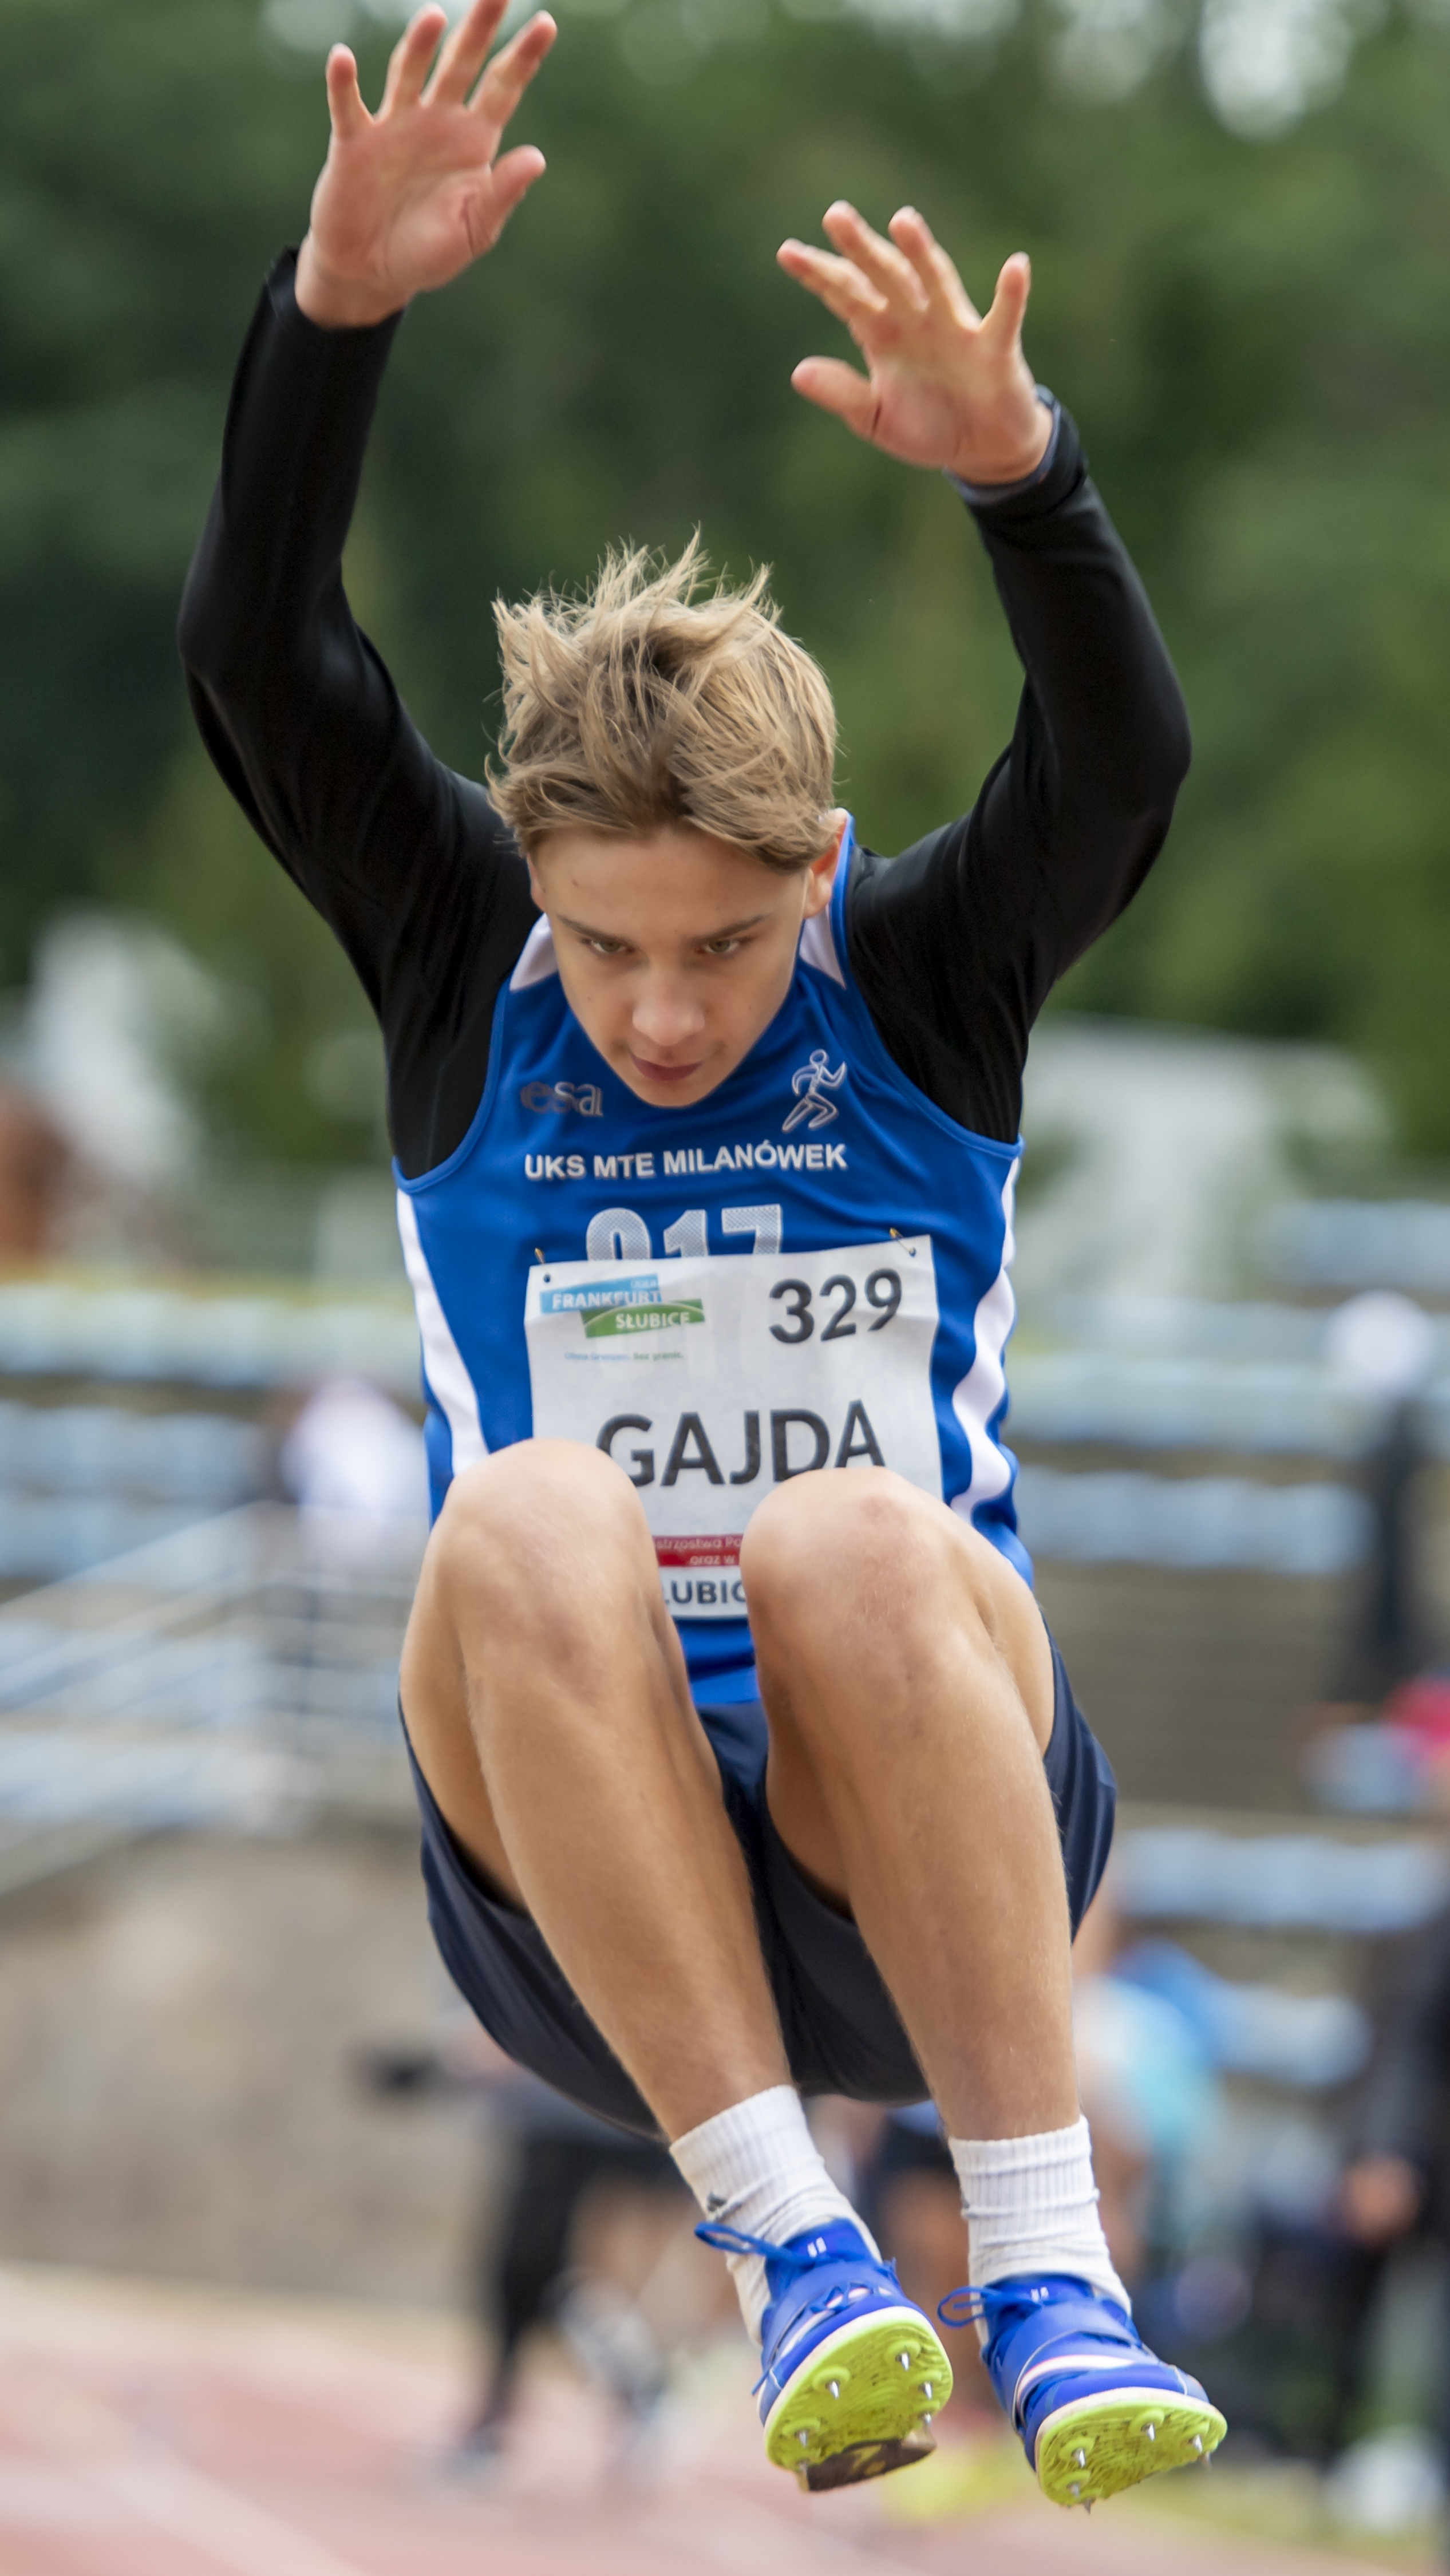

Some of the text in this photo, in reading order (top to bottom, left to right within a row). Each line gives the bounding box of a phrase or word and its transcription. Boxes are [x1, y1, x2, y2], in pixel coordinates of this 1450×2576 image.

[524, 1139, 848, 1180] UKS MTE MILANÓWEK
[552, 1290, 662, 1310] FRANKFURT
[769, 1268, 902, 1344] 329
[615, 1312, 690, 1329] SŁUBICE
[596, 1399, 886, 1488] GAJDA
[690, 1555, 721, 1566] oraz
[665, 1579, 746, 1604] UBIC
